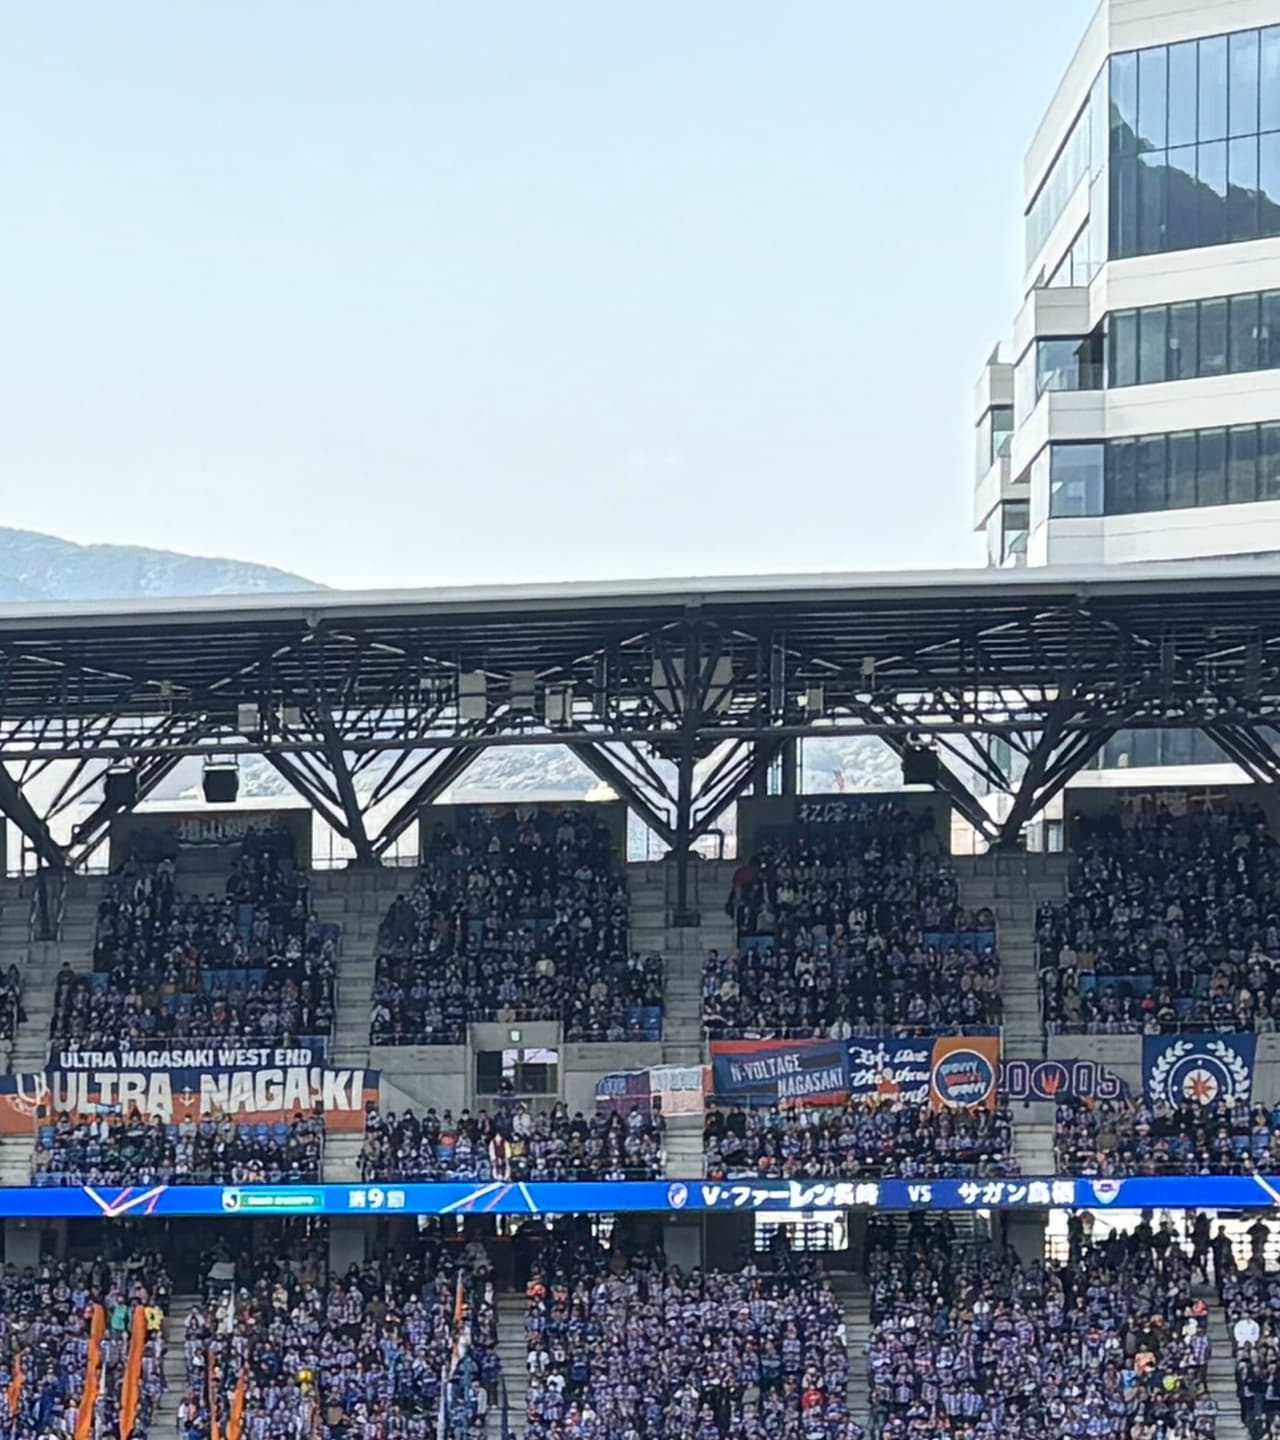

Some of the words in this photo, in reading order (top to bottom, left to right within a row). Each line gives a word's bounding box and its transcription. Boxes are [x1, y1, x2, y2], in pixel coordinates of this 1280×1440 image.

[60, 1050, 116, 1069] ULTRA
[121, 1049, 214, 1068] NAGASAKI
[219, 1048, 270, 1067] WEST
[275, 1047, 312, 1066] END
[729, 1053, 801, 1083] N-VOLTAGE
[52, 1070, 173, 1123] ULTRA
[200, 1067, 364, 1114] NAGAKI
[777, 1068, 845, 1099] NAGASAKI
[908, 1184, 931, 1203] VS
